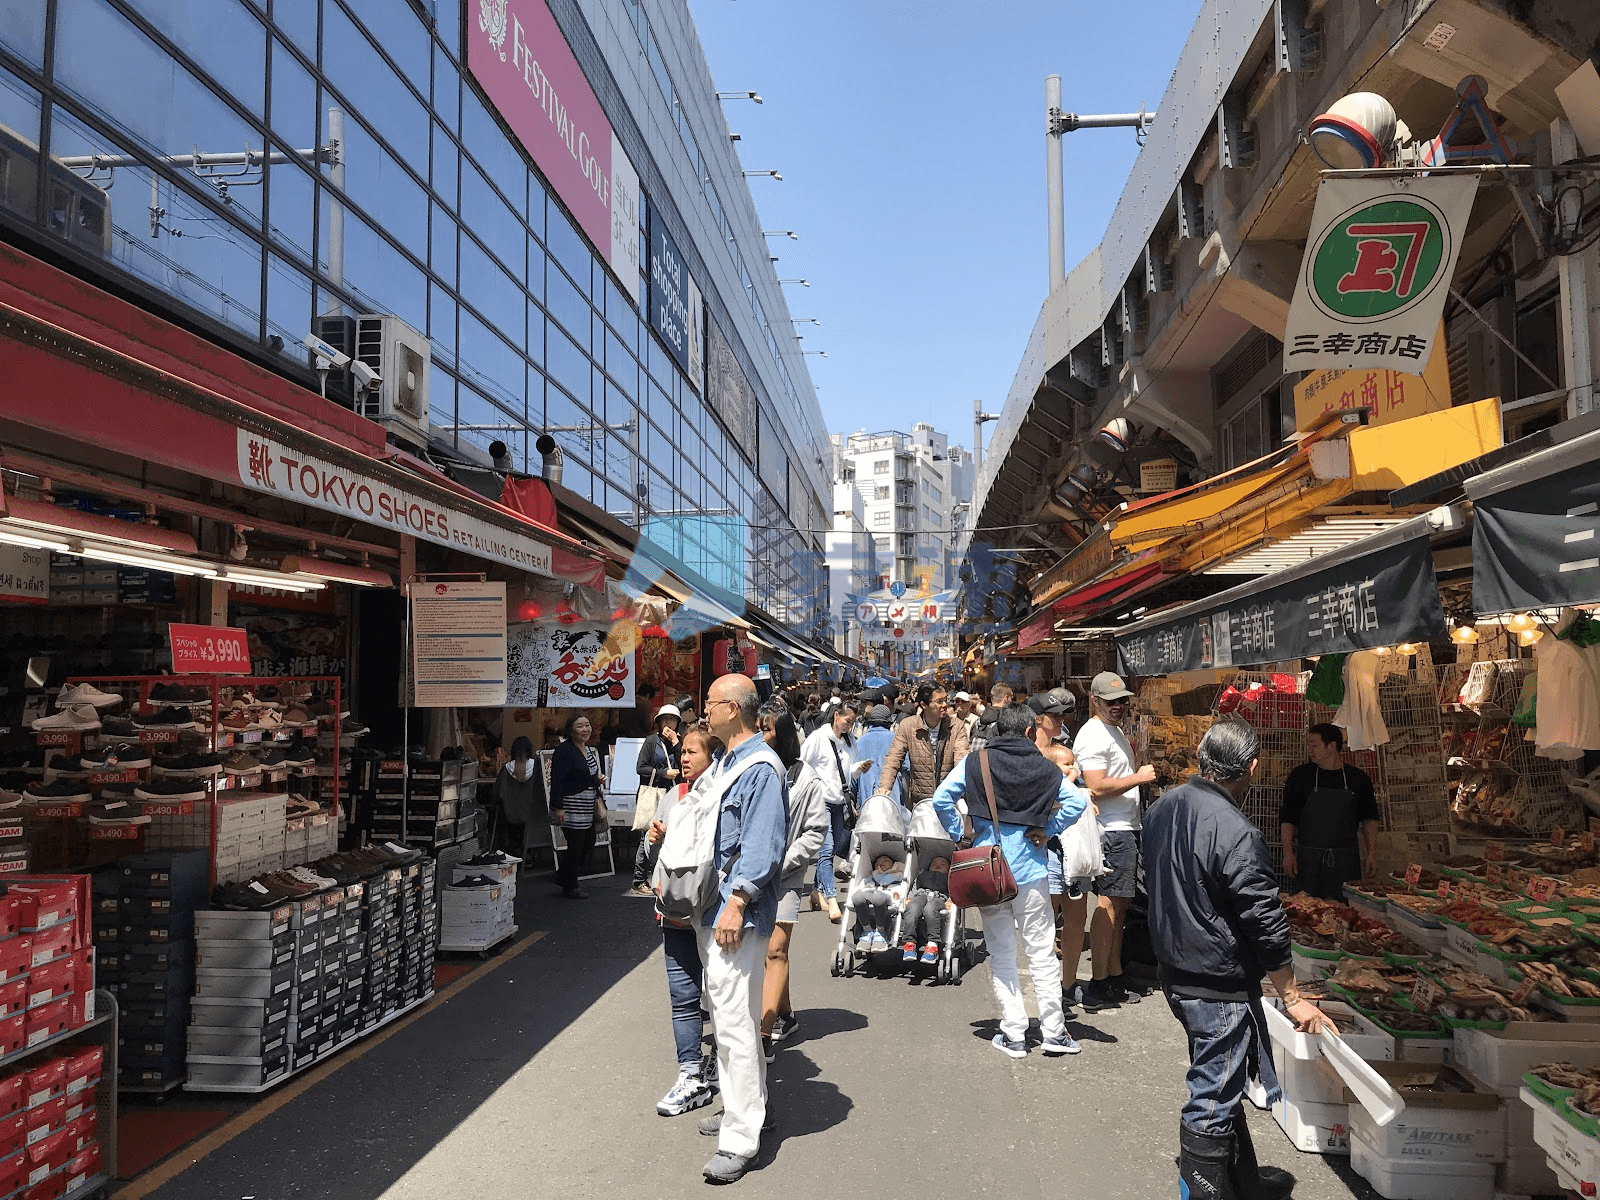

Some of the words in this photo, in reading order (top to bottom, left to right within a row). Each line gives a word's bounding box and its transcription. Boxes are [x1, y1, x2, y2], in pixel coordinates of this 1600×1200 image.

[512, 12, 578, 160] FESTIVAL
[579, 130, 610, 209] GOLF
[661, 232, 682, 290] Total
[652, 255, 689, 335] shopping
[660, 303, 682, 352] place
[1288, 331, 1427, 360] 三幸商店
[248, 439, 276, 492] 靴
[279, 455, 375, 518] TOKYO
[378, 494, 451, 542] SHOES
[452, 528, 508, 559] RETAILING
[22, 551, 42, 566] Shop
[859, 604, 938, 620] アメ横
[1231, 605, 1276, 653] 三幸商店
[1306, 574, 1380, 638] 三幸商店
[175, 638, 199, 648] スペシャル
[178, 649, 198, 658] プライス
[1157, 629, 1184, 664] 三幸商店
